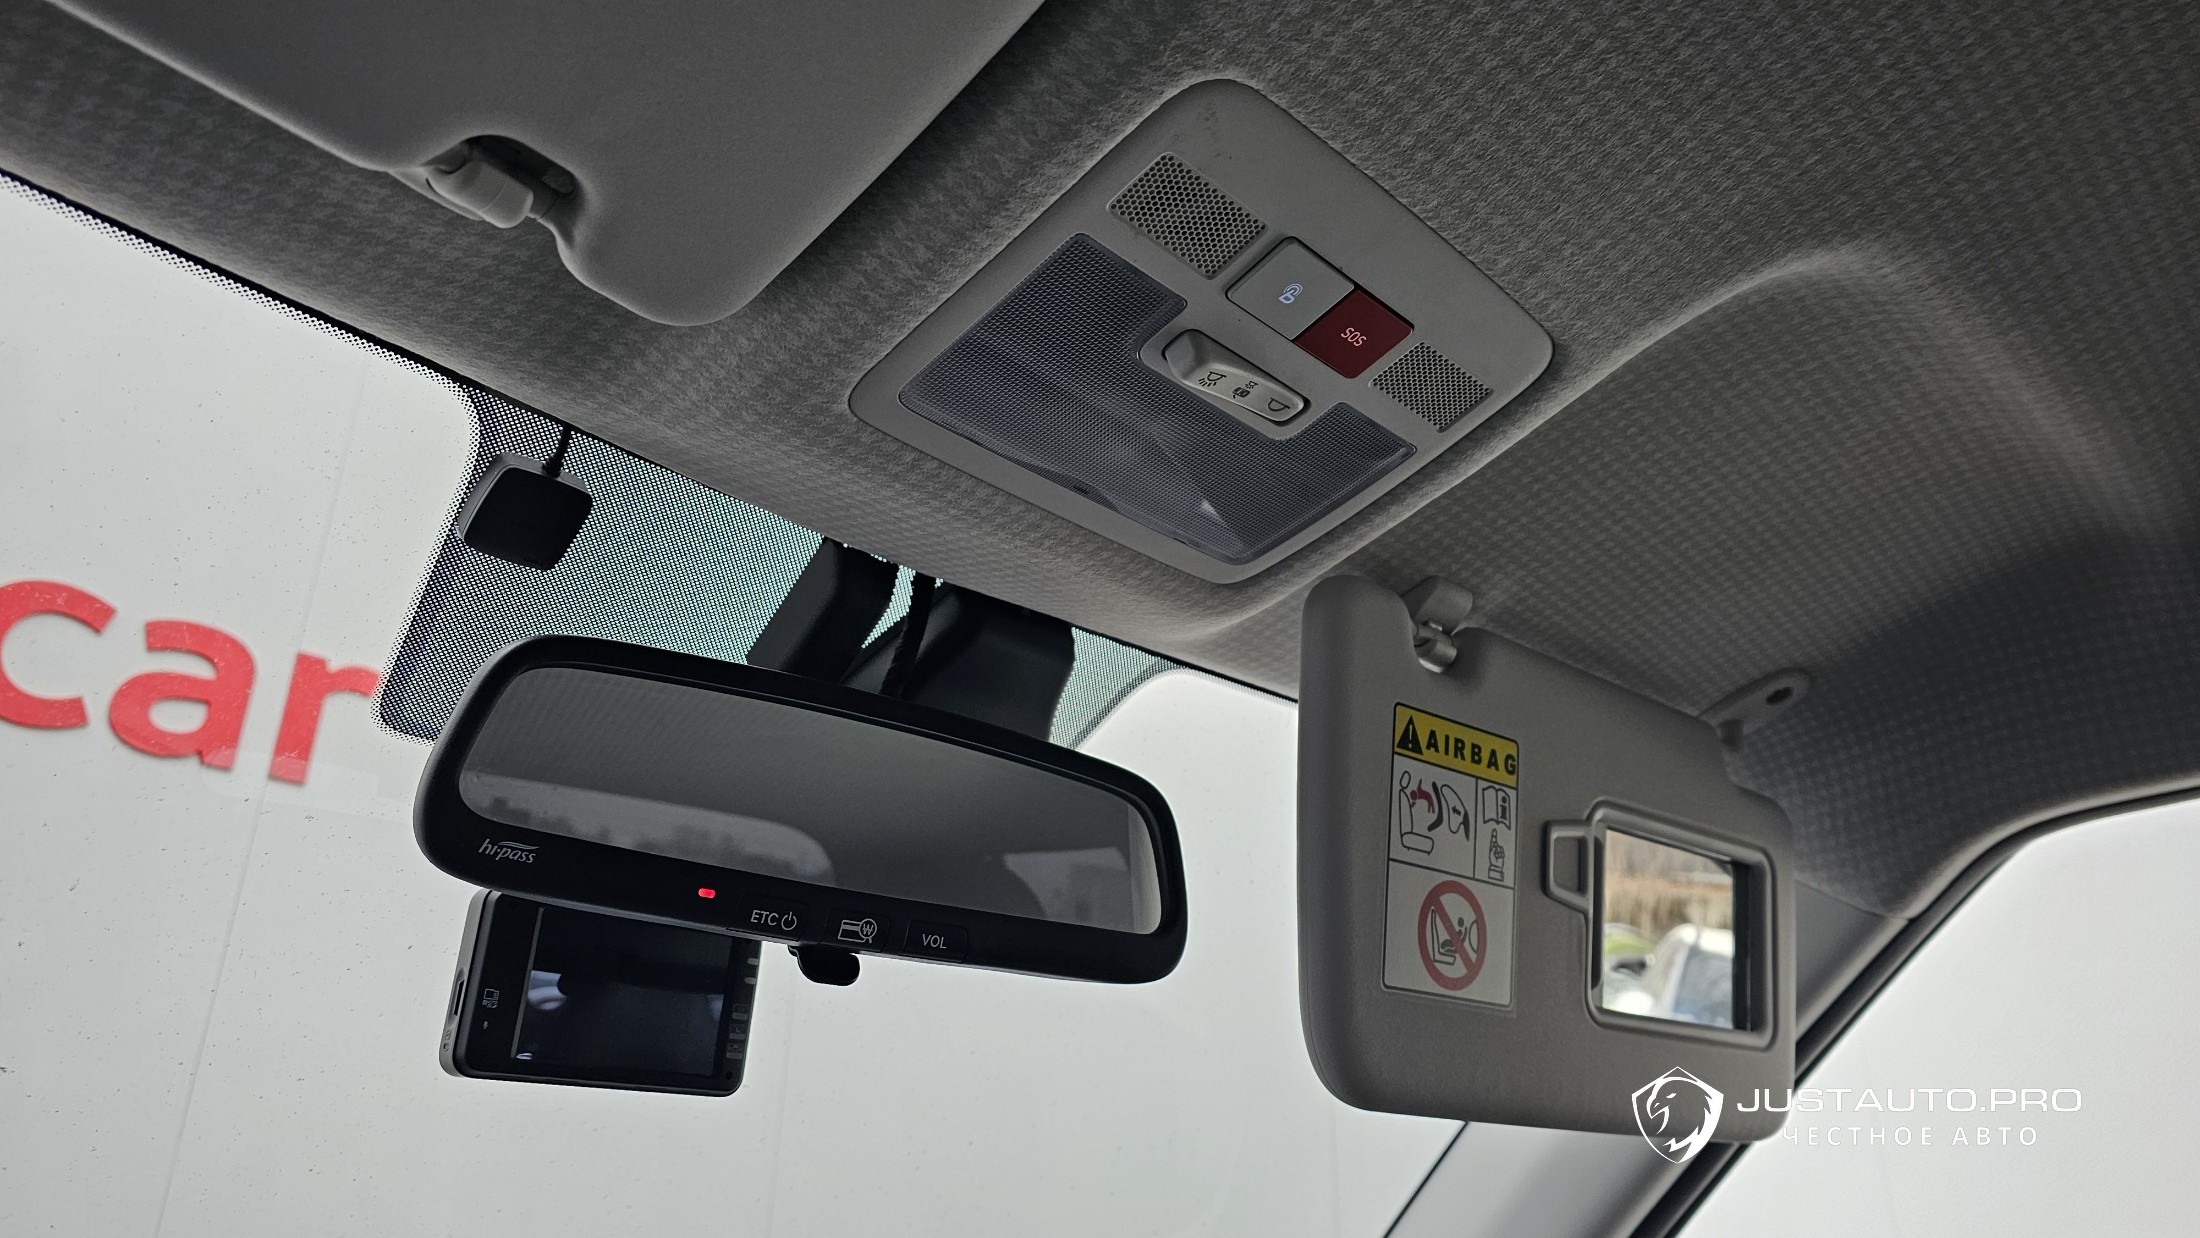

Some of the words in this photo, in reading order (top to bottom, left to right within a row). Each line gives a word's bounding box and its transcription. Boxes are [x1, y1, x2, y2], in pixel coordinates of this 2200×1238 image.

[1341, 327, 1367, 347] SOS
[0, 580, 381, 786] car
[1425, 729, 1517, 776] AIRBAG
[750, 909, 779, 926] ETC
[922, 933, 947, 949] VOL
